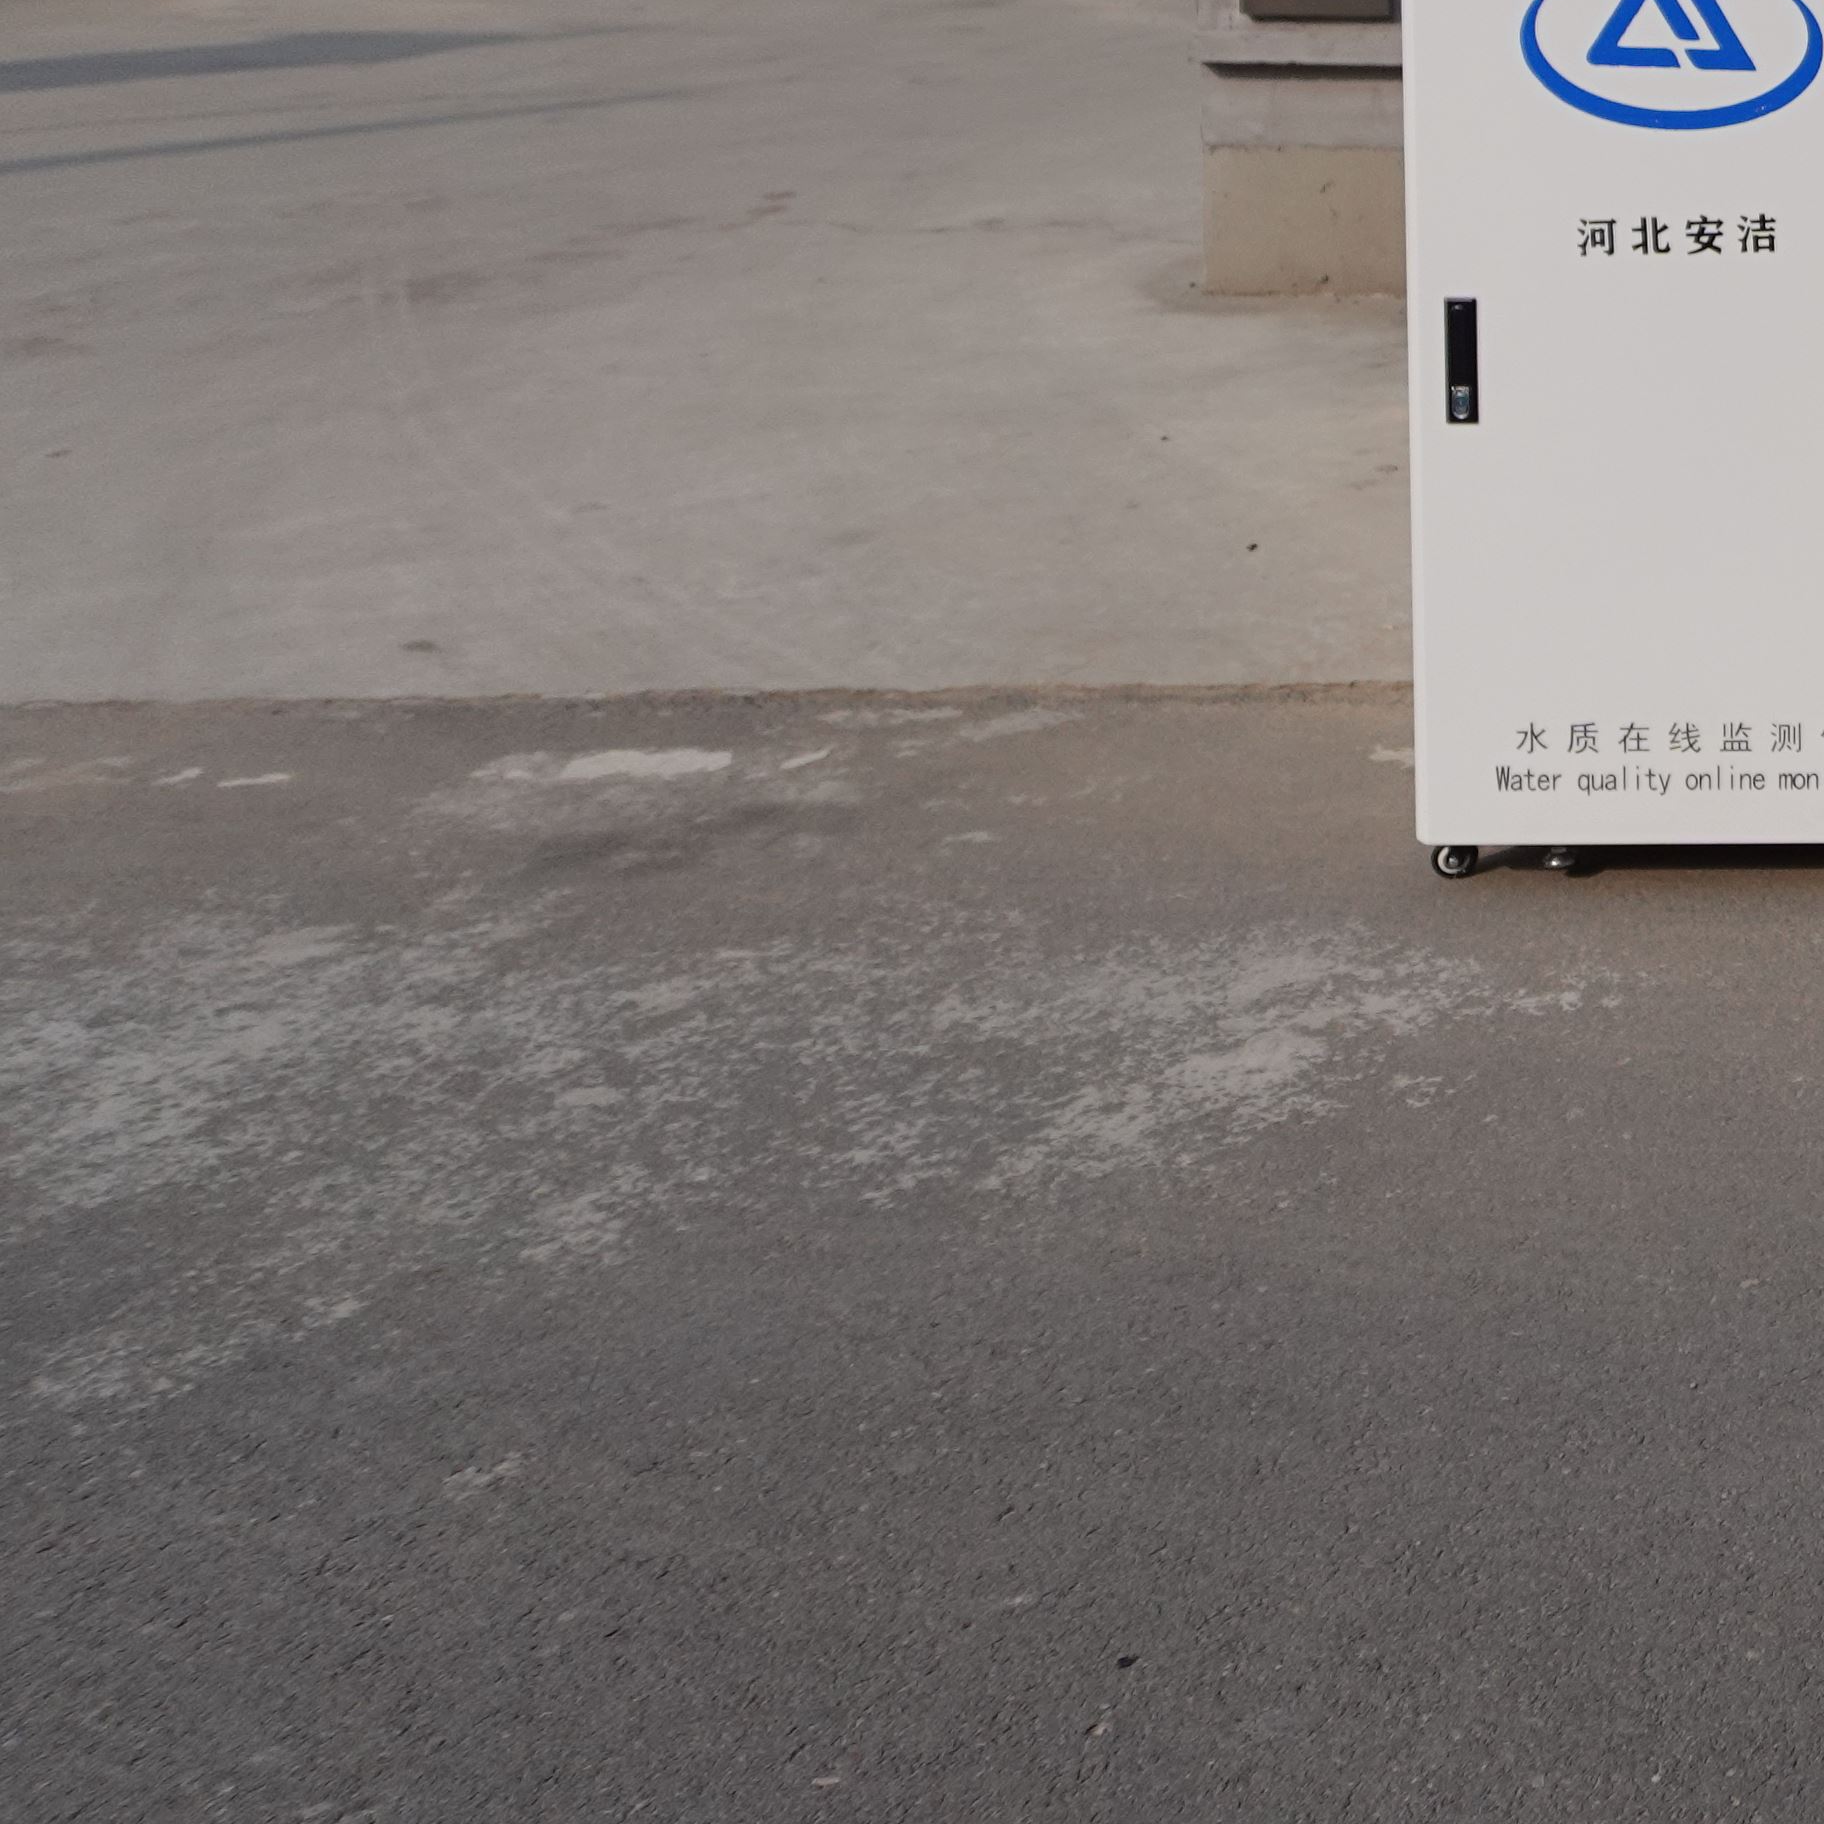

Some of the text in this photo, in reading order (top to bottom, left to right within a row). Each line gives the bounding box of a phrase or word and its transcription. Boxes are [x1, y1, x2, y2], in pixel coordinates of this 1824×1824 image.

[1576, 212, 1777, 257] 河北安洁
[1495, 765, 1563, 793] Water
[1577, 765, 1672, 797] quality
[1684, 764, 1766, 792] online
